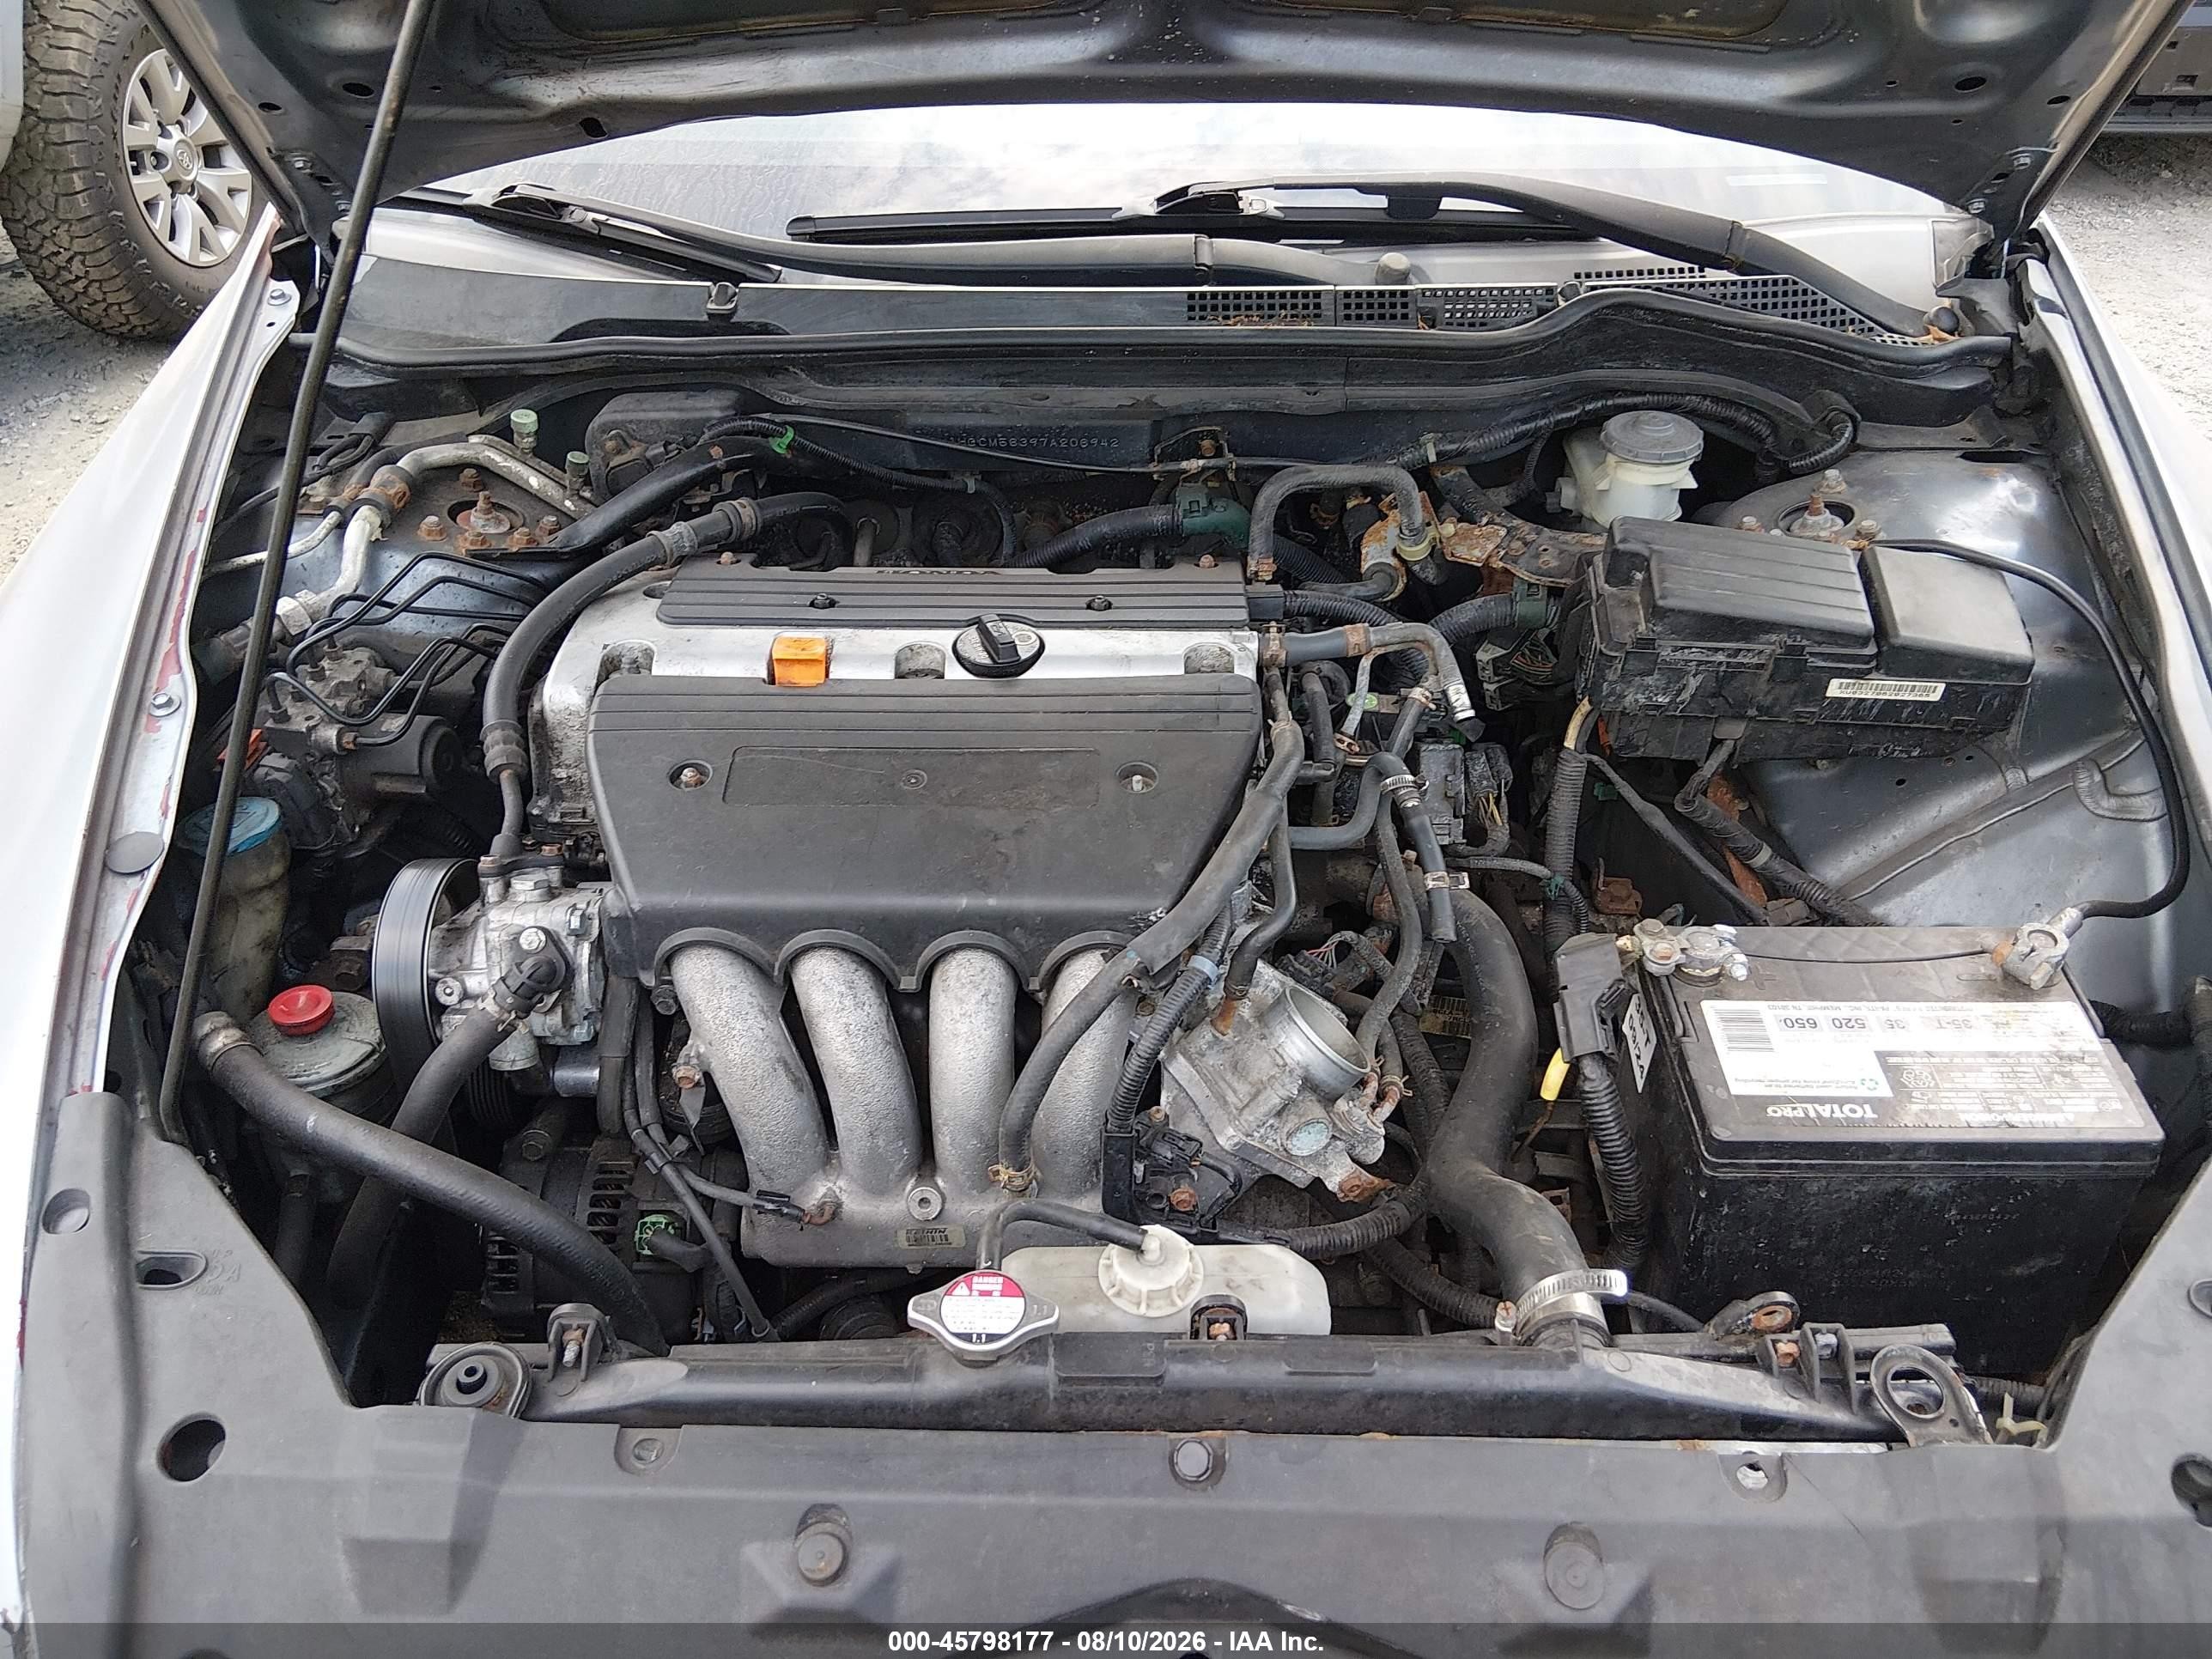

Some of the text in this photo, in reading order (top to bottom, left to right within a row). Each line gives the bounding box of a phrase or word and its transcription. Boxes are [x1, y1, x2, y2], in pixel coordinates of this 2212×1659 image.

[1831, 1018, 1867, 1030] 520
[1885, 1018, 1906, 1030] 35
[1936, 1018, 1973, 1030] 35-T
[1765, 1103, 1879, 1118] TOTALPRO
[972, 1333, 987, 1343] 1.1
